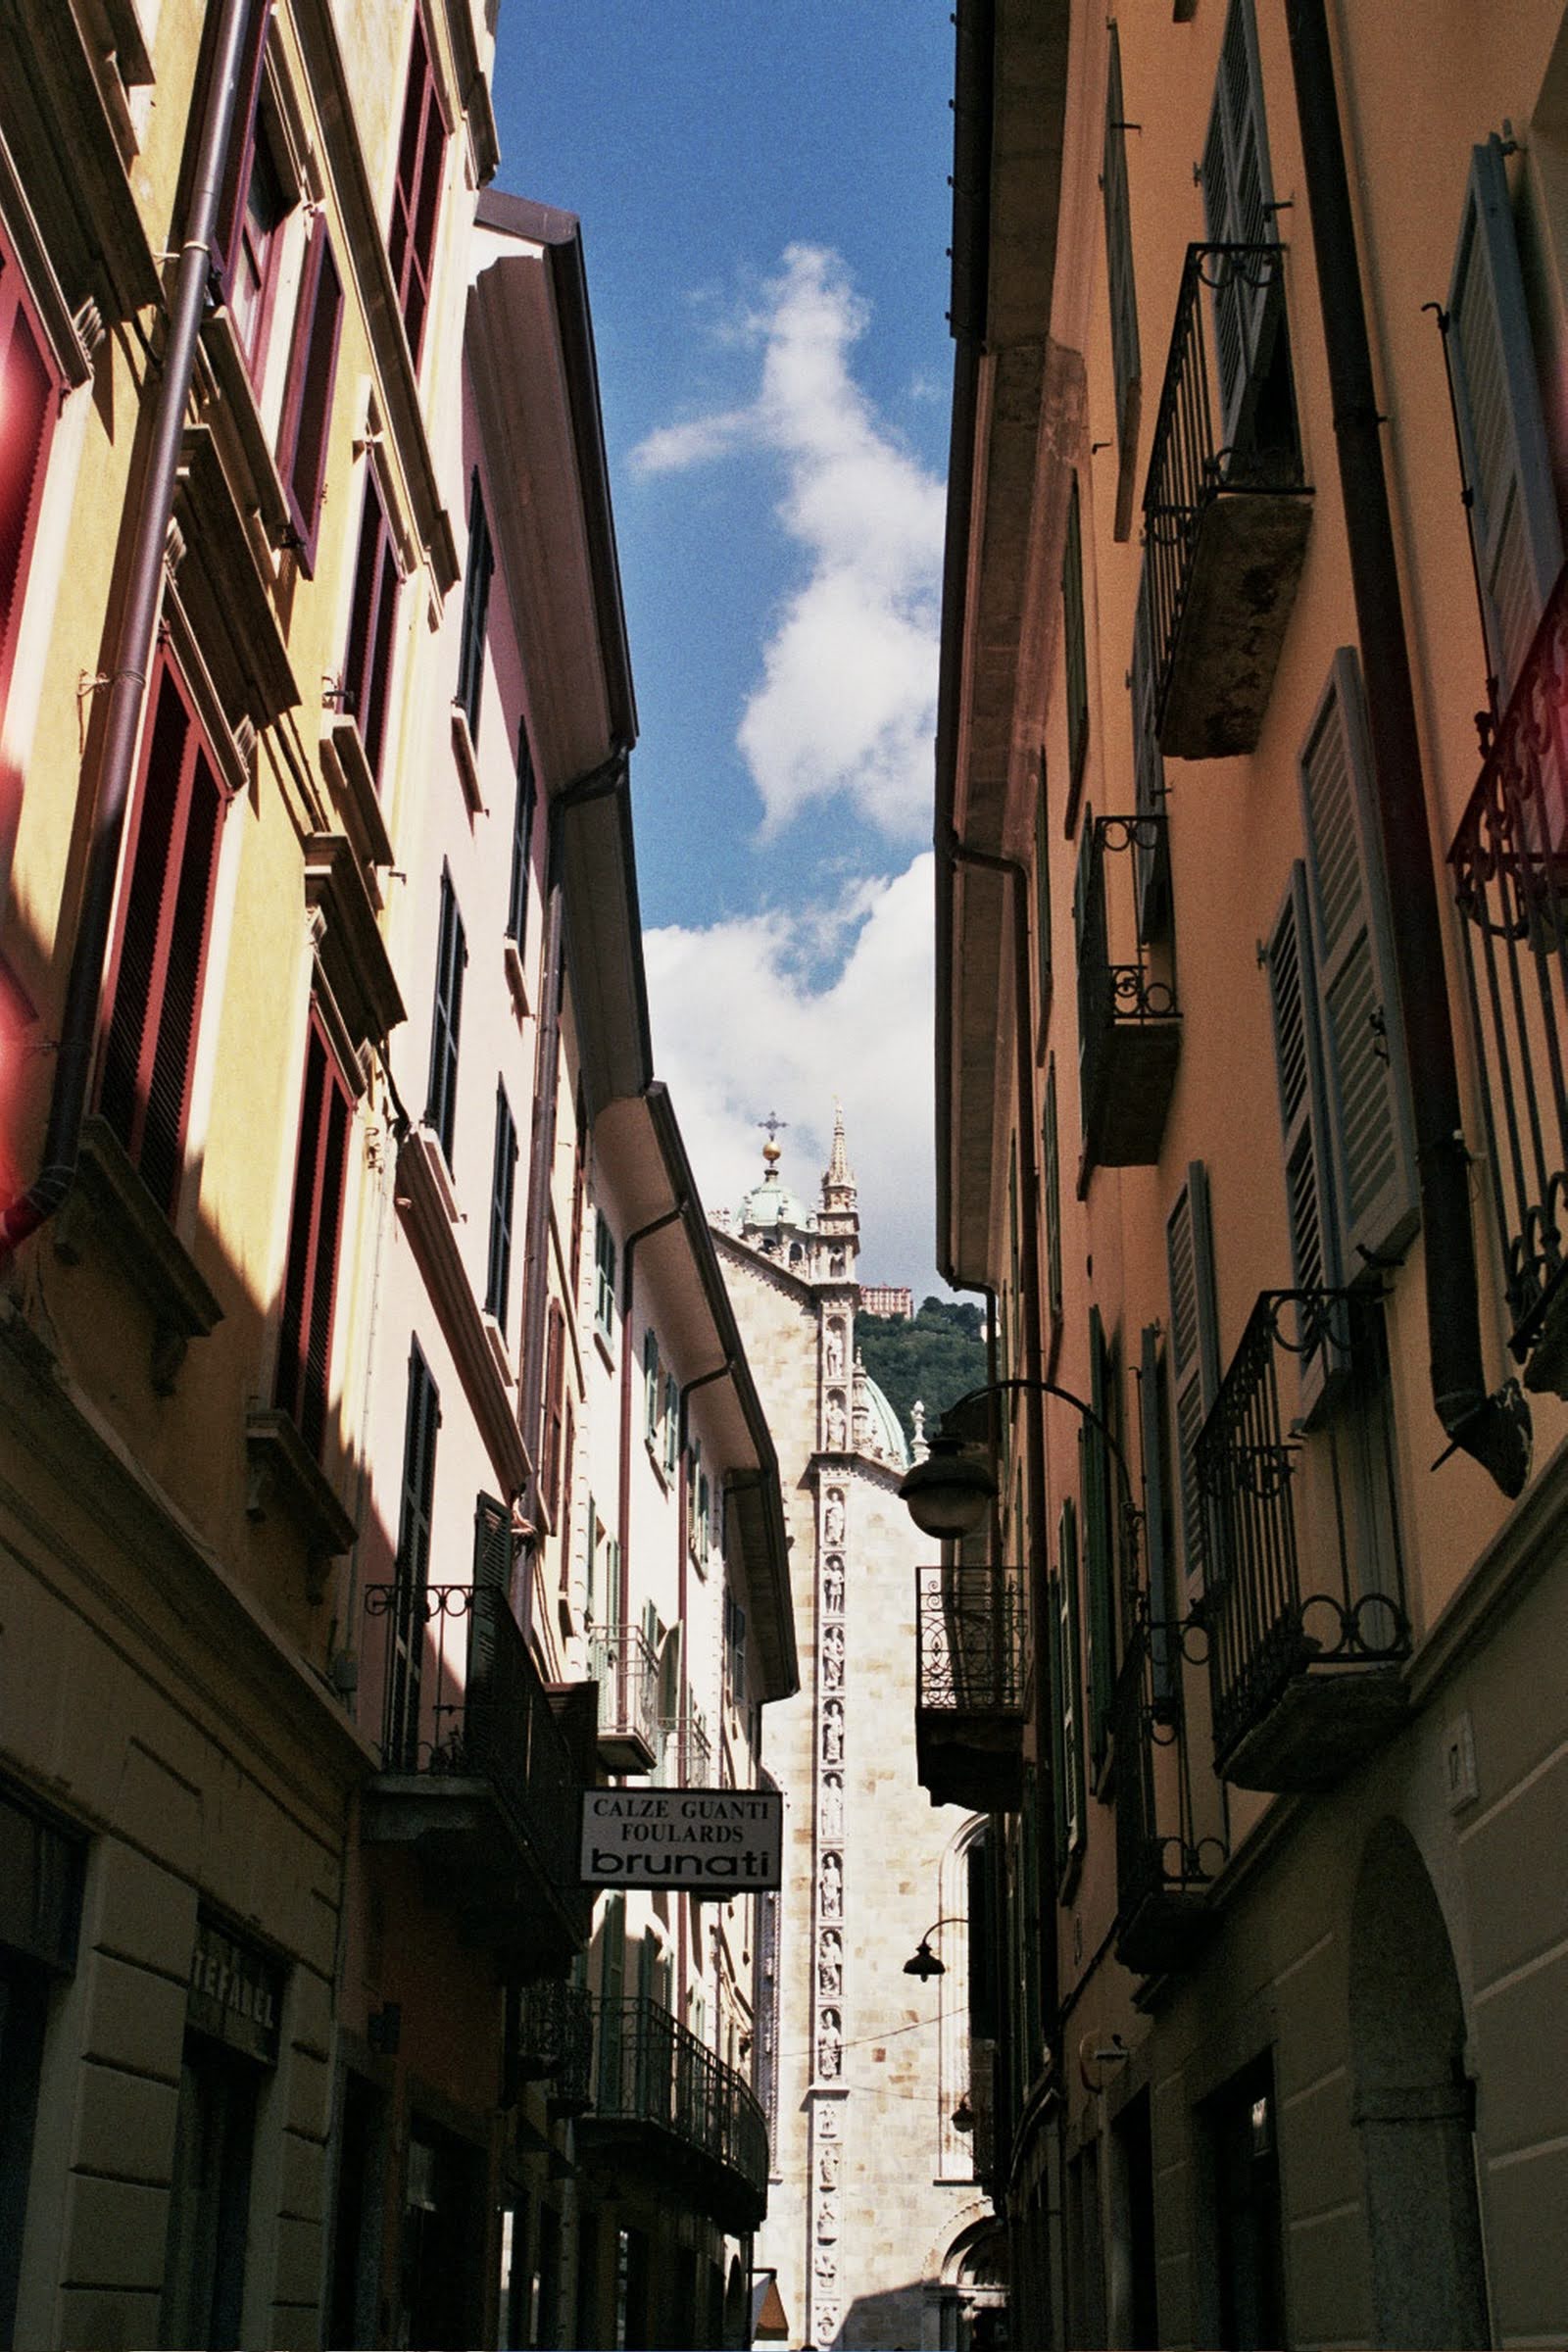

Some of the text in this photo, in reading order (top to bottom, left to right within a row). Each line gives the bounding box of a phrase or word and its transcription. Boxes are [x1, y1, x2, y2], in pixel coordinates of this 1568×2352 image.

[593, 1798, 769, 1820] CALZE GUANTI
[620, 1823, 745, 1843] FOULARDS
[591, 1848, 769, 1878] brunati
